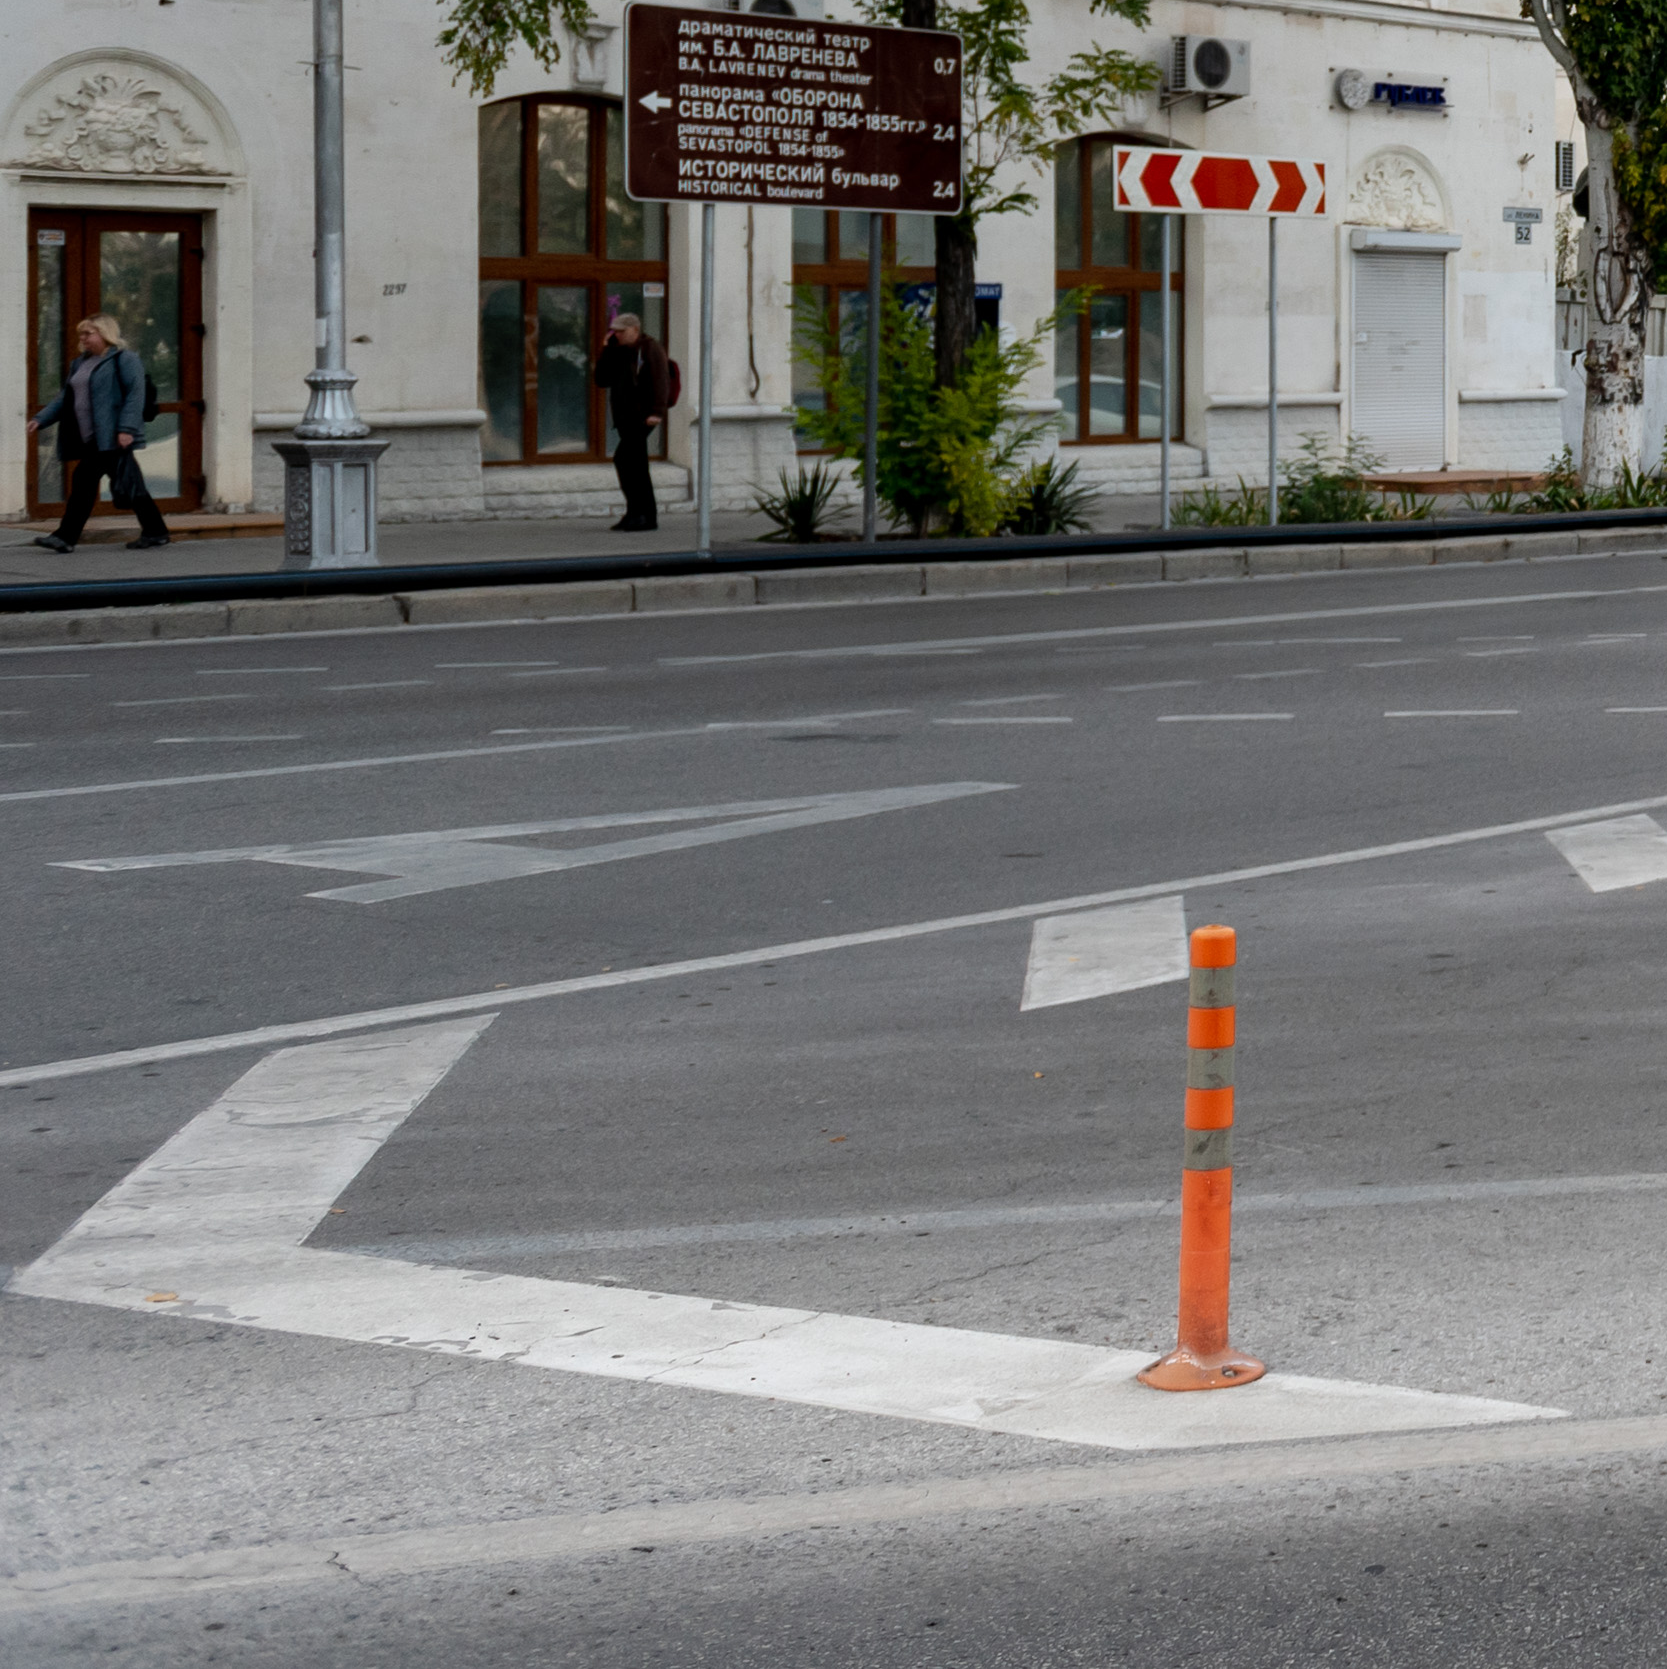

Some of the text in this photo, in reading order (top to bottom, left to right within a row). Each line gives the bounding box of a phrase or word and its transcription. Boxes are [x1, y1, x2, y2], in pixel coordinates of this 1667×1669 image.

[678, 19, 871, 53] драматический театр
[679, 39, 859, 68] им. Б.А. ЛАВРЕНЕВА
[709, 59, 786, 79] LAVRENEV
[790, 69, 825, 81] drama
[830, 70, 873, 85] theater
[934, 57, 956, 75] 0,7
[679, 83, 864, 110] панорама «ОБОРОНА
[679, 100, 815, 126] СЕВАСТОПОЛЯ
[677, 123, 829, 143] panorama «DEFENSE of
[933, 124, 955, 142] 2,4
[678, 136, 845, 159] SEVASTOPOL 1854-1855»
[679, 159, 900, 191] ИСТОРИЧЕСКИЙ бульвар
[678, 180, 824, 200] HISTORICAL boulevard
[933, 181, 955, 199] 2,4
[1516, 226, 1531, 241] 52
